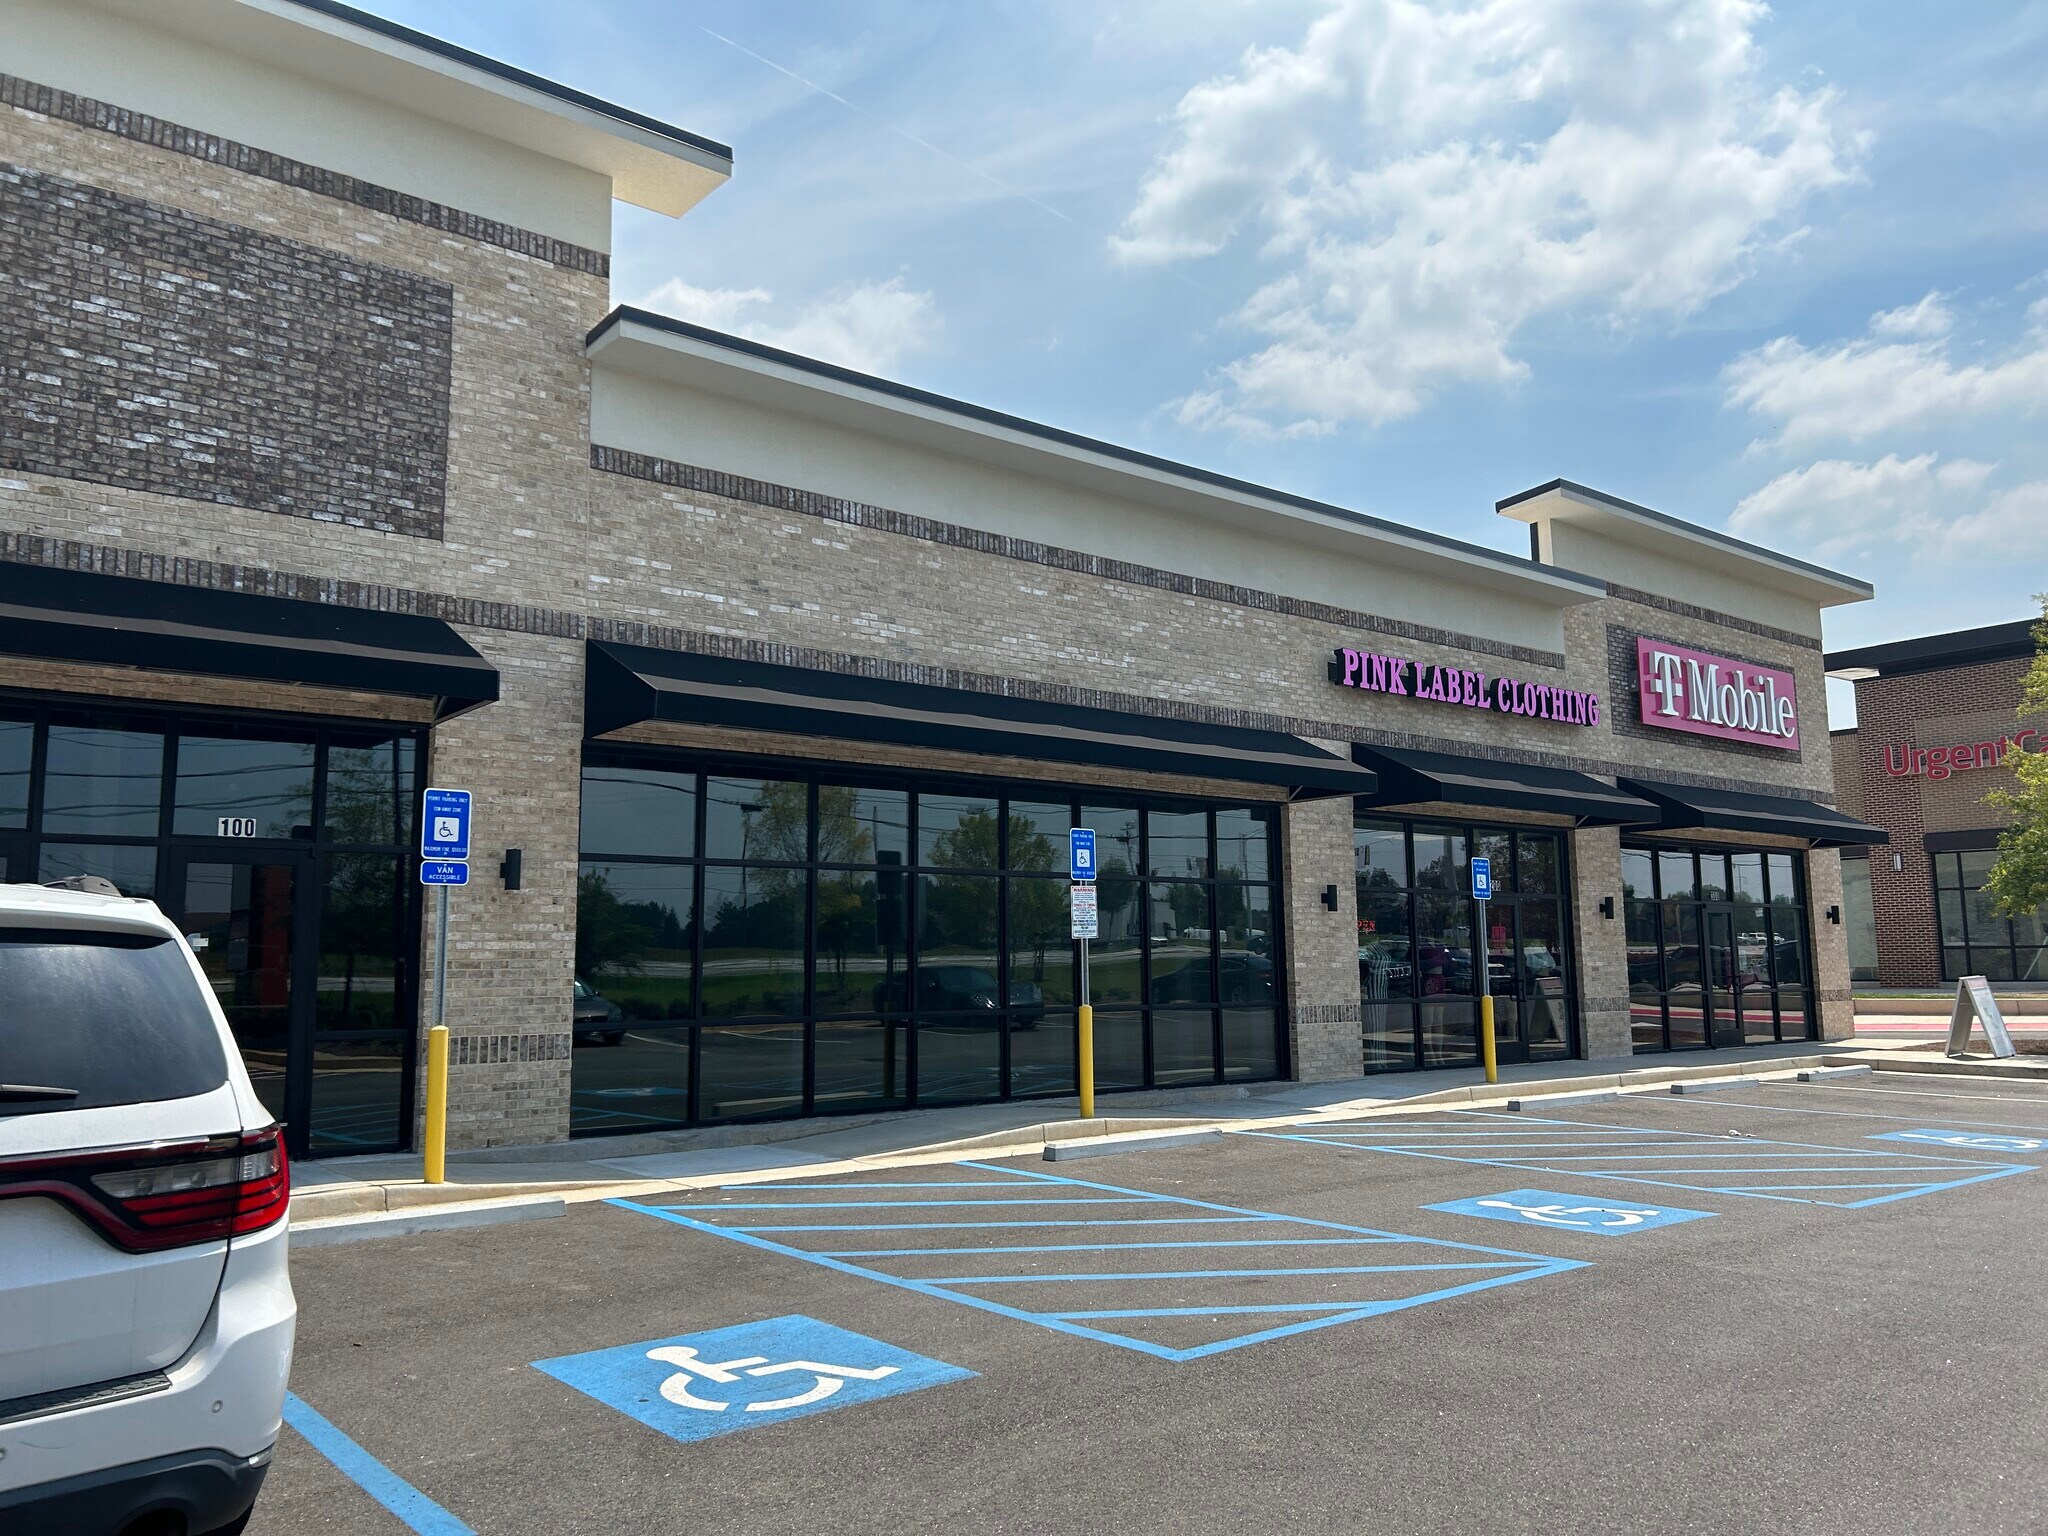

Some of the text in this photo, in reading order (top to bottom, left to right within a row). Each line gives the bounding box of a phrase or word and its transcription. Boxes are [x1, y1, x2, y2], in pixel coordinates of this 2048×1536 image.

[1343, 648, 1600, 727] PINK LABEL CLOTHING
[221, 818, 255, 837] 100
[437, 866, 454, 874] VAN
